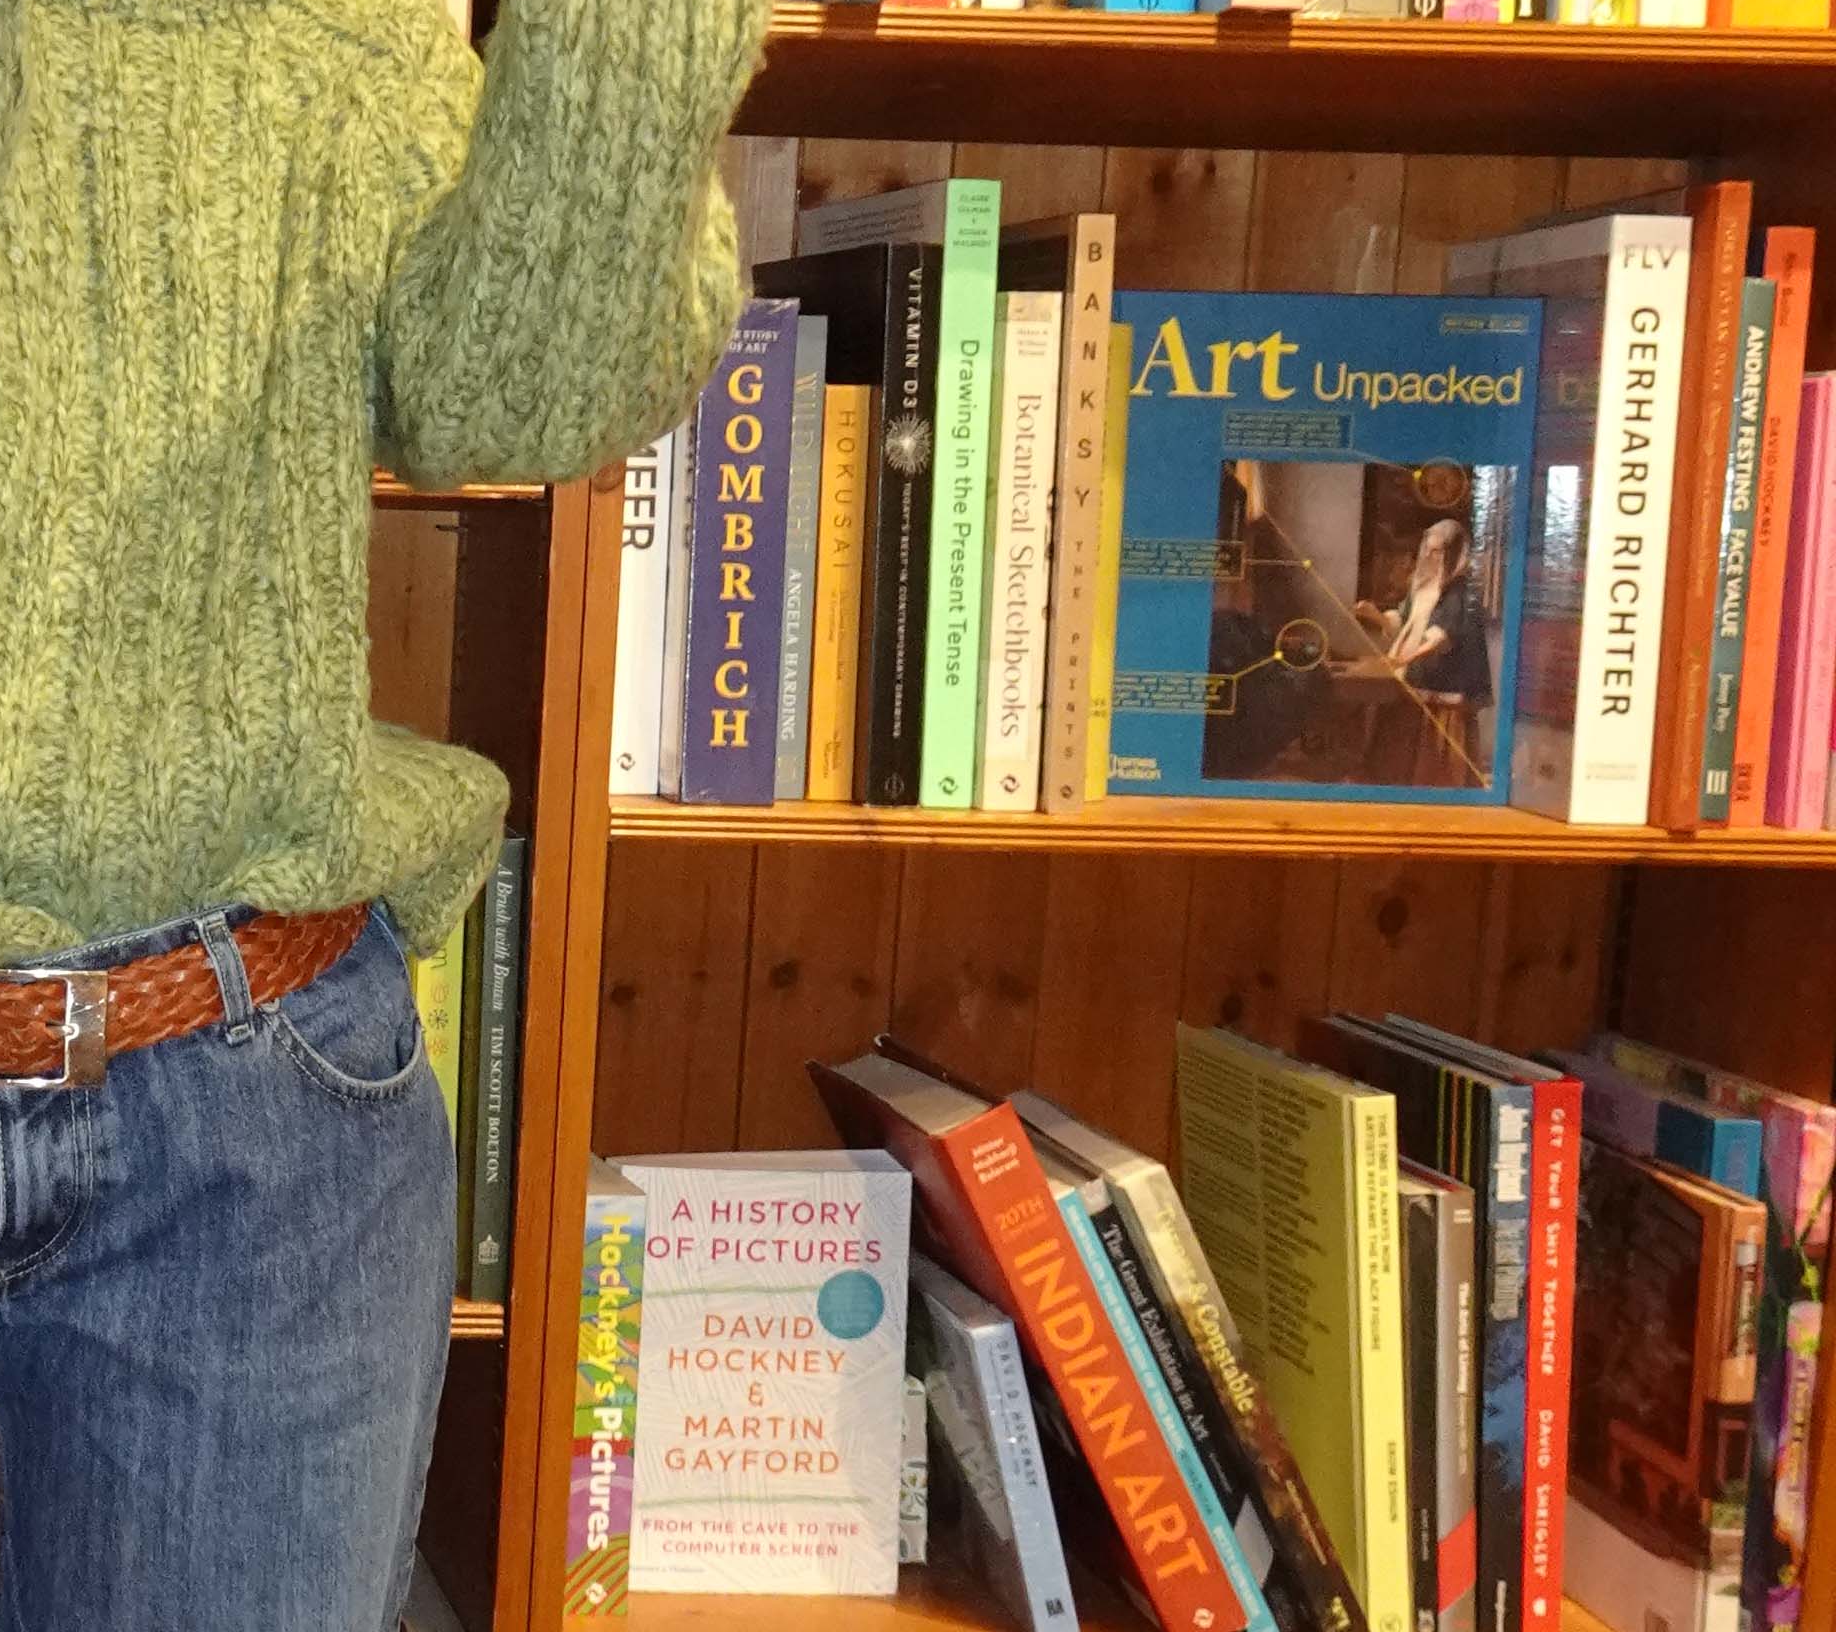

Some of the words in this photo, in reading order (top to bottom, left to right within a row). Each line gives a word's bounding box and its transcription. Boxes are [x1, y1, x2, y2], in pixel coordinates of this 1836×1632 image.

[905, 267, 924, 369] VITAMIN
[1130, 315, 1299, 402] Art
[953, 338, 979, 441] Drawing
[1073, 241, 1102, 509] BANKSY
[1313, 362, 1523, 408] Unpacked
[1617, 305, 1660, 517] GERHARD
[1736, 324, 1766, 426] ANDREW
[833, 409, 856, 569] HOKUSAI
[955, 477, 972, 516] the
[957, 447, 973, 471] in
[1010, 393, 1042, 535] Botanical
[1728, 429, 1758, 511] FESTING
[710, 363, 765, 748] GOMBRICH
[949, 525, 972, 613] Present
[787, 572, 804, 643] ANGELA
[1001, 544, 1035, 737] Sketchbooks
[1600, 535, 1643, 718] RICHTER
[780, 648, 800, 741] HARDING
[945, 618, 968, 688] Tense
[647, 1236, 694, 1259] OF
[711, 1238, 882, 1263] PICTURES
[672, 1200, 694, 1223] A
[711, 1200, 862, 1224] HISTORY
[594, 1214, 632, 1399] Hockney's
[704, 1314, 814, 1338] DAVID
[668, 1348, 846, 1373] HOCKNEY
[684, 1416, 824, 1440] MARTIN
[1013, 1238, 1149, 1459] INDIAN
[1115, 1475, 1211, 1580] ART
[586, 1406, 624, 1553] Pictures
[665, 1448, 840, 1474] GAYFORD
[642, 1520, 694, 1533] FROM
[701, 1520, 734, 1534] THE
[742, 1520, 788, 1534] CAVE
[796, 1522, 820, 1535] TO
[827, 1522, 860, 1536] THE
[662, 1540, 762, 1556] COMPUTER
[768, 1542, 838, 1556] SCREEN
